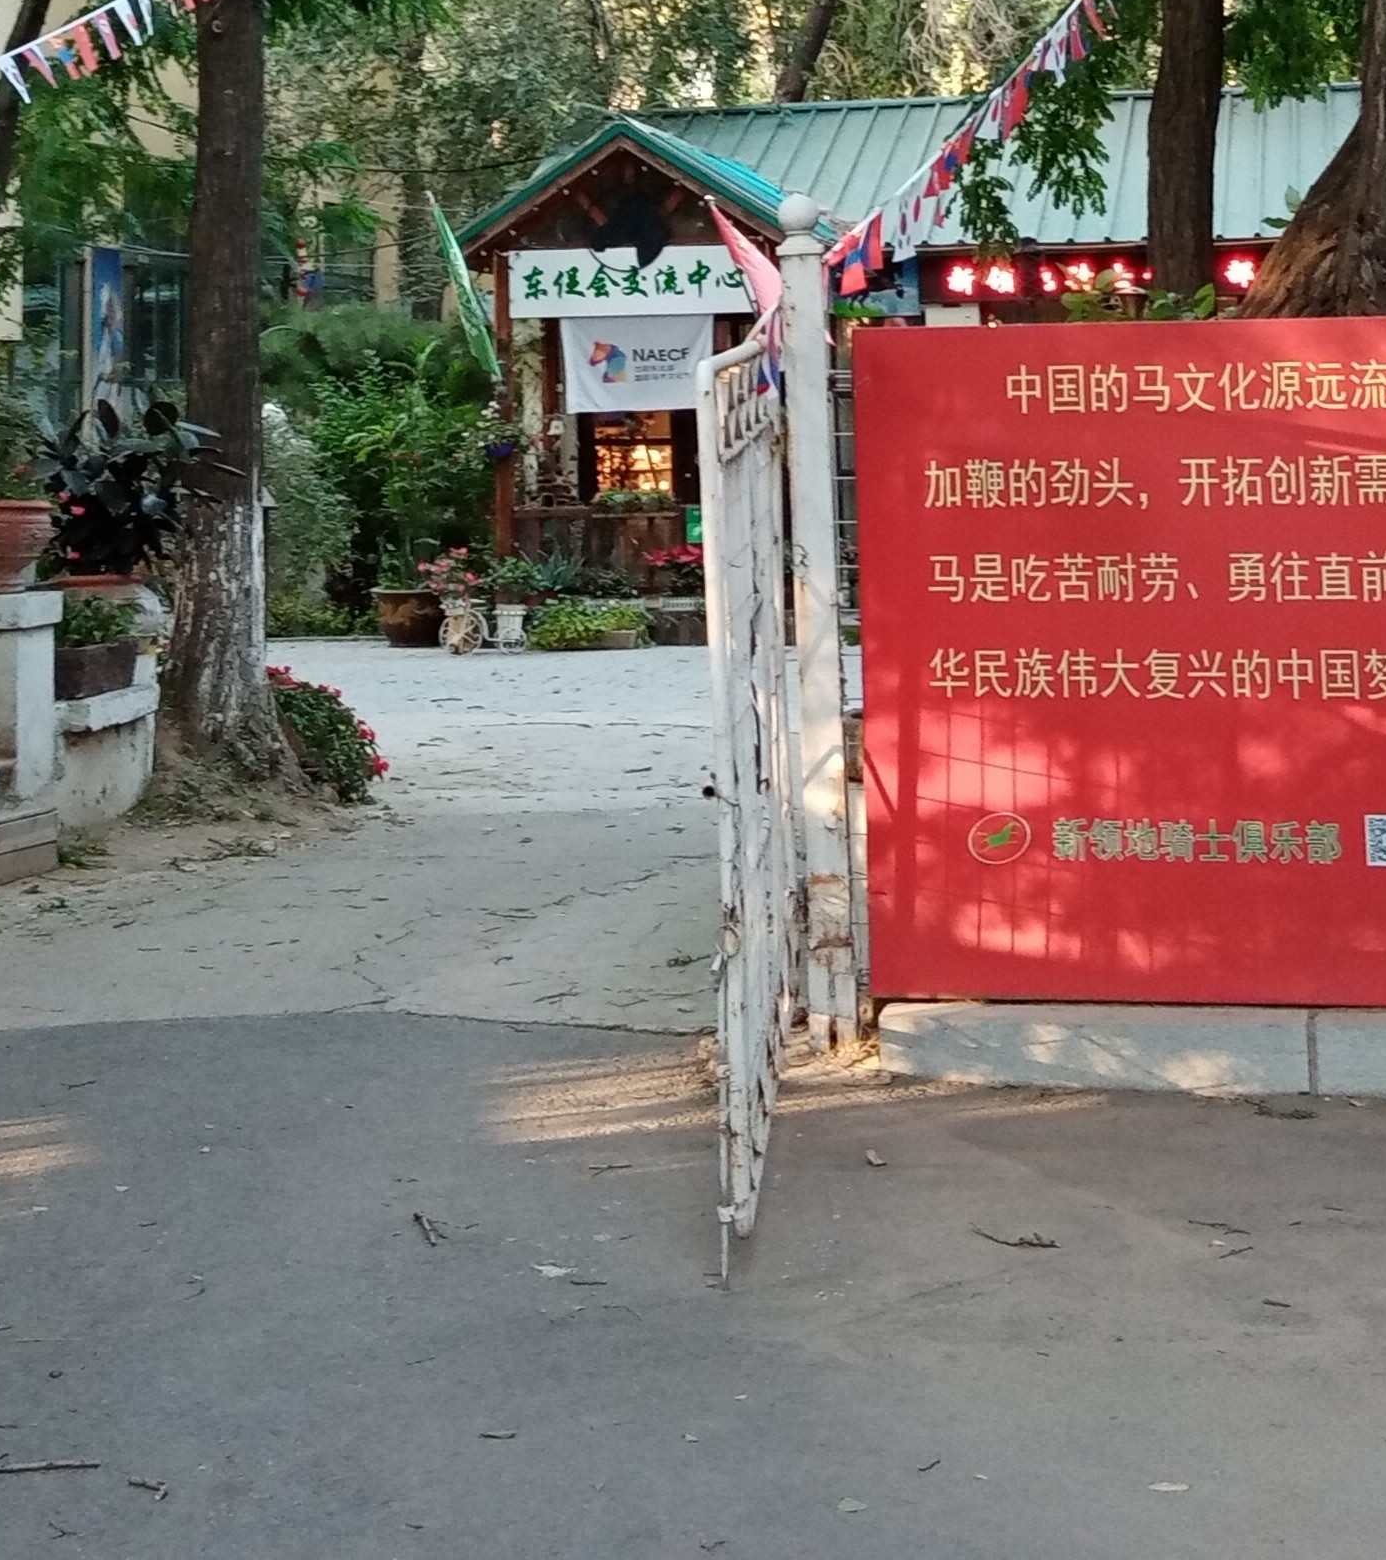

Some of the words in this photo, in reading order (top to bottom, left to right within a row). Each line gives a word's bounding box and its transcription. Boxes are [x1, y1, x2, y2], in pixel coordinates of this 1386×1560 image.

[632, 347, 690, 362] NAECF
[1051, 816, 1343, 865] 新领地骑士俱乐部
